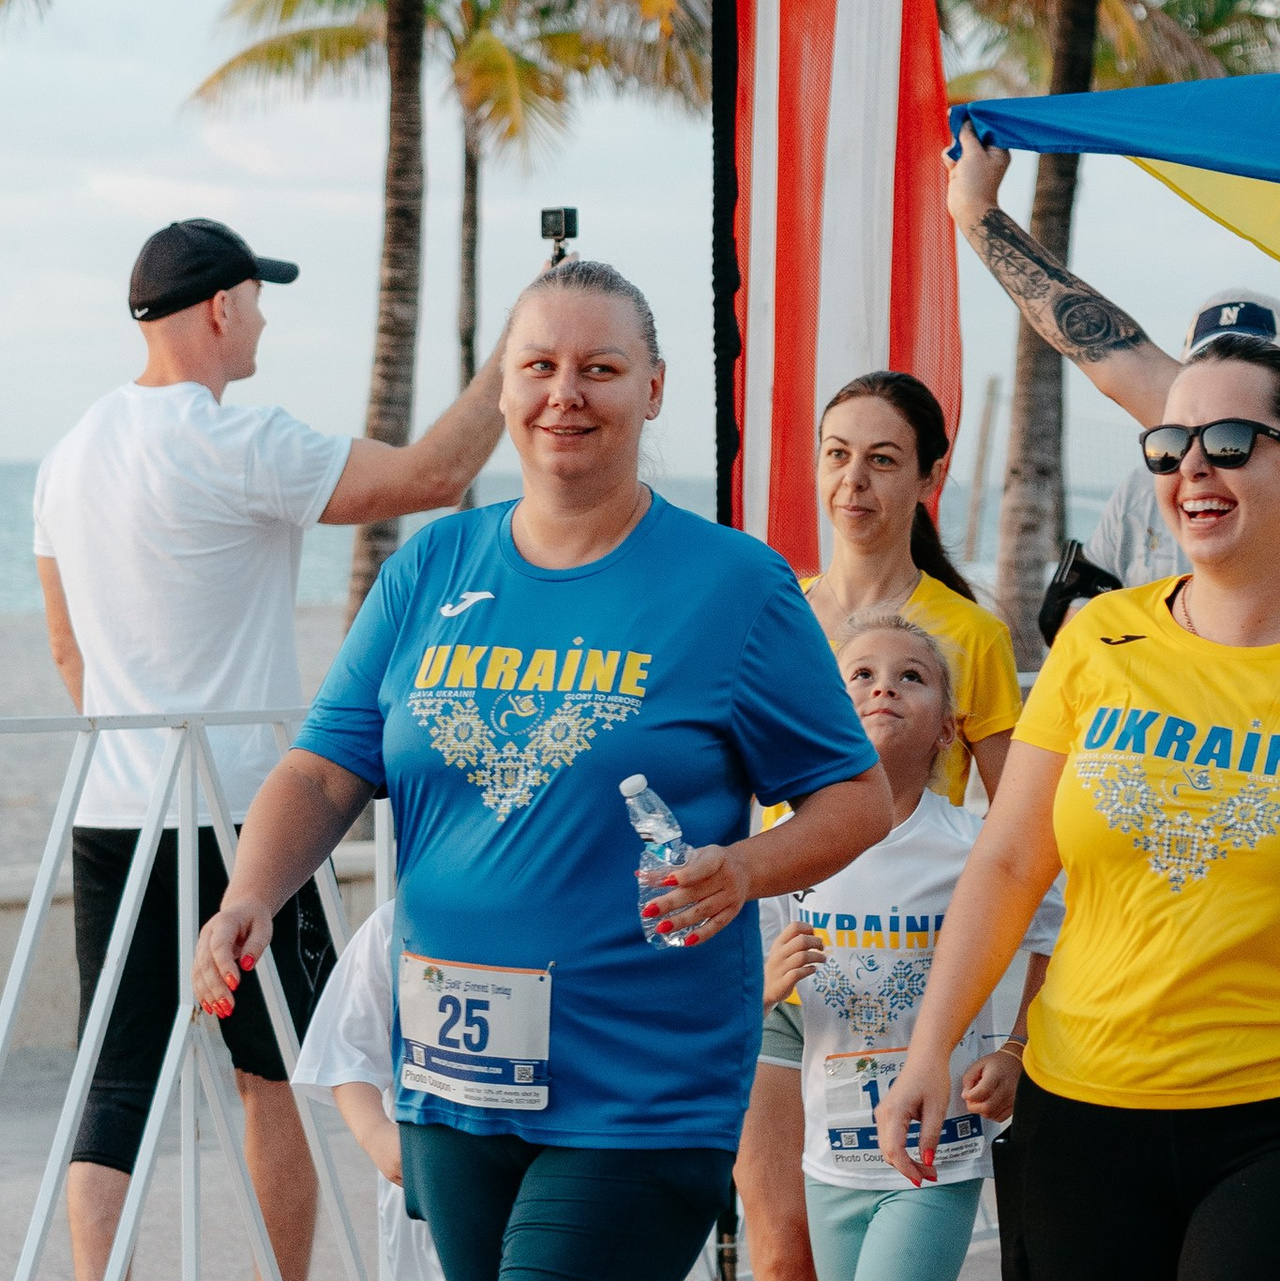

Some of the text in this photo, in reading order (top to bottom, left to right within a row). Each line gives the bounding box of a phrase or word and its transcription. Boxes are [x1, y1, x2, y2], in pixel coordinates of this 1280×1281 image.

[414, 643, 653, 698] UKRAINE
[564, 693, 594, 701] GLORY
[594, 694, 606, 702] TO
[438, 994, 490, 1053] 25
[404, 1068, 428, 1082] Photo
[862, 1077, 898, 1124] 1
[835, 1152, 885, 1164] Photo Coup
